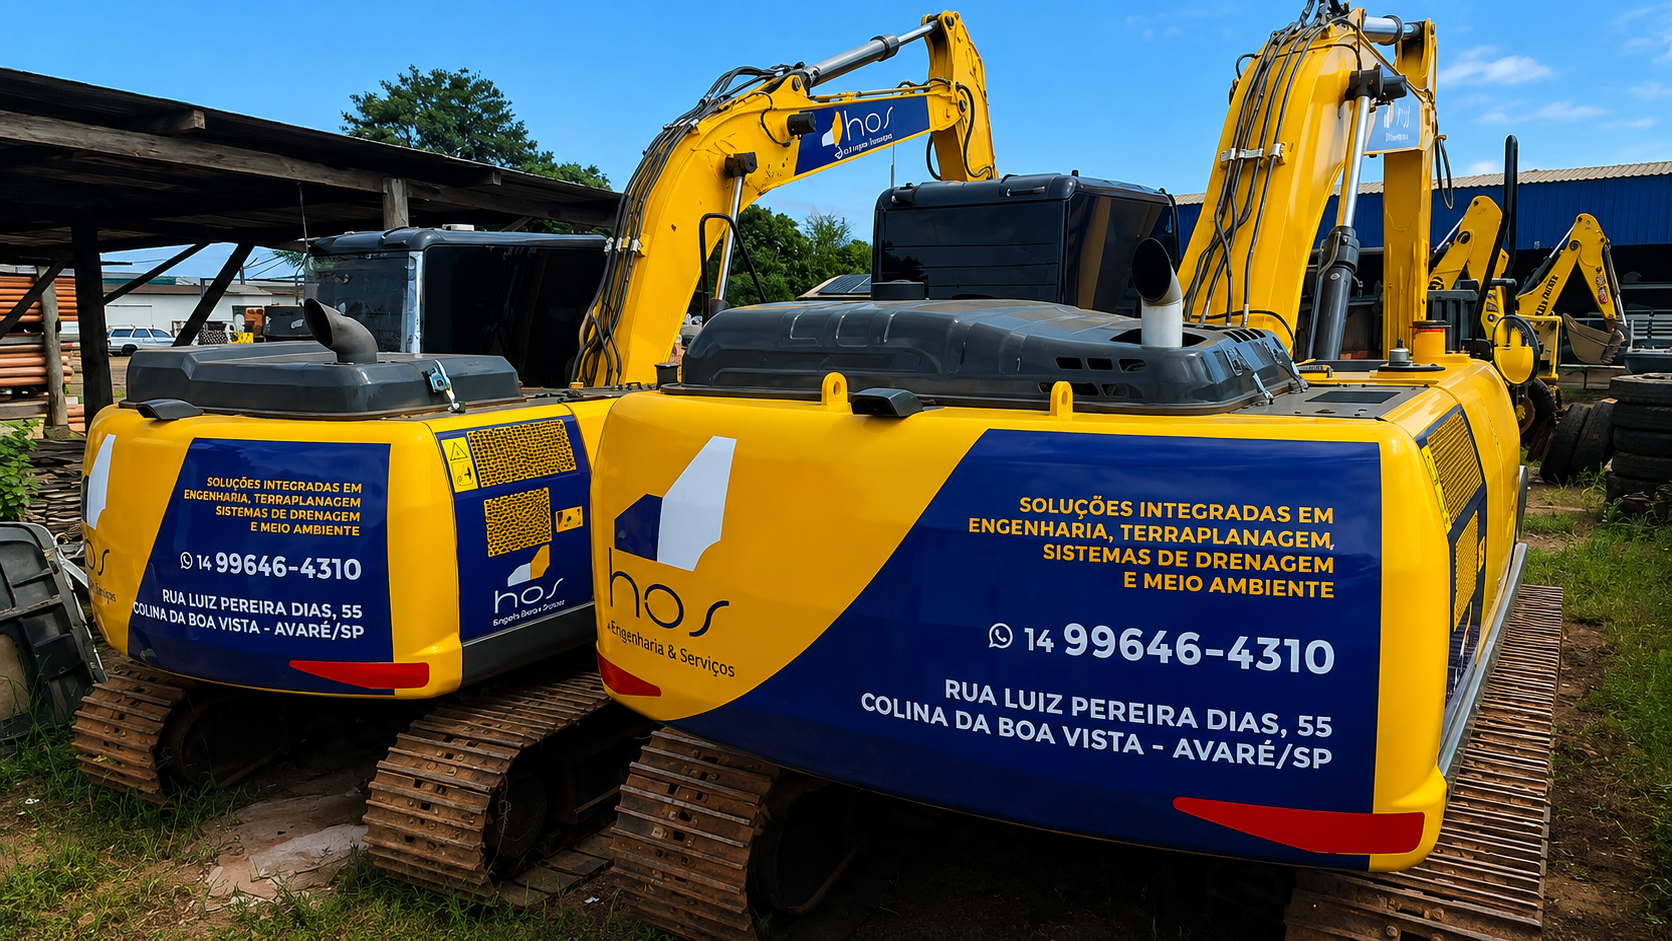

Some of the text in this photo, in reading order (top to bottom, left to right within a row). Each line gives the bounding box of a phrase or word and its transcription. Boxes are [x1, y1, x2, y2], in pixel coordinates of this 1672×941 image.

[843, 106, 893, 142] hos
[183, 489, 362, 508] ENGENHARIA, TERRAPLANAGEM
[206, 476, 363, 494] SOLUÇÕES INTEGRADAS EM
[215, 505, 361, 522] SISTEMAS DE DRENAGEM
[1018, 493, 1335, 525] SOLUÇÕES INTEGRADAS EM
[250, 521, 361, 537] E MEIO AMBIENTE
[968, 517, 1335, 551] ENGENHARIA, TERRAPLANAGEM,
[196, 552, 362, 581] 14 99646-4310
[1043, 543, 1335, 574] SISTEMAS DE DRENAGEM
[494, 577, 564, 614] hos
[608, 546, 730, 638] hos
[1123, 571, 1335, 599] E MEIO AMBIENTE
[162, 588, 363, 621] RUA LUIZ PEREIRA DIAS, 55
[132, 601, 168, 622] COLINA
[169, 609, 187, 626] DA
[188, 612, 217, 631] BOA
[218, 616, 261, 635] VISTA
[274, 619, 365, 642] AVARÉ/SP
[611, 620, 735, 678] Engenharia & Serviços
[1023, 622, 1335, 675] 14 99646-4310
[945, 679, 1333, 739] RUA LUIZ PEREIRA DIAS, 55
[861, 692, 949, 727] COLINA
[955, 710, 992, 735] DA
[998, 716, 1056, 745] BOA
[1061, 725, 1146, 755] VISTA
[1172, 738, 1334, 770] AVARÉ/SP
